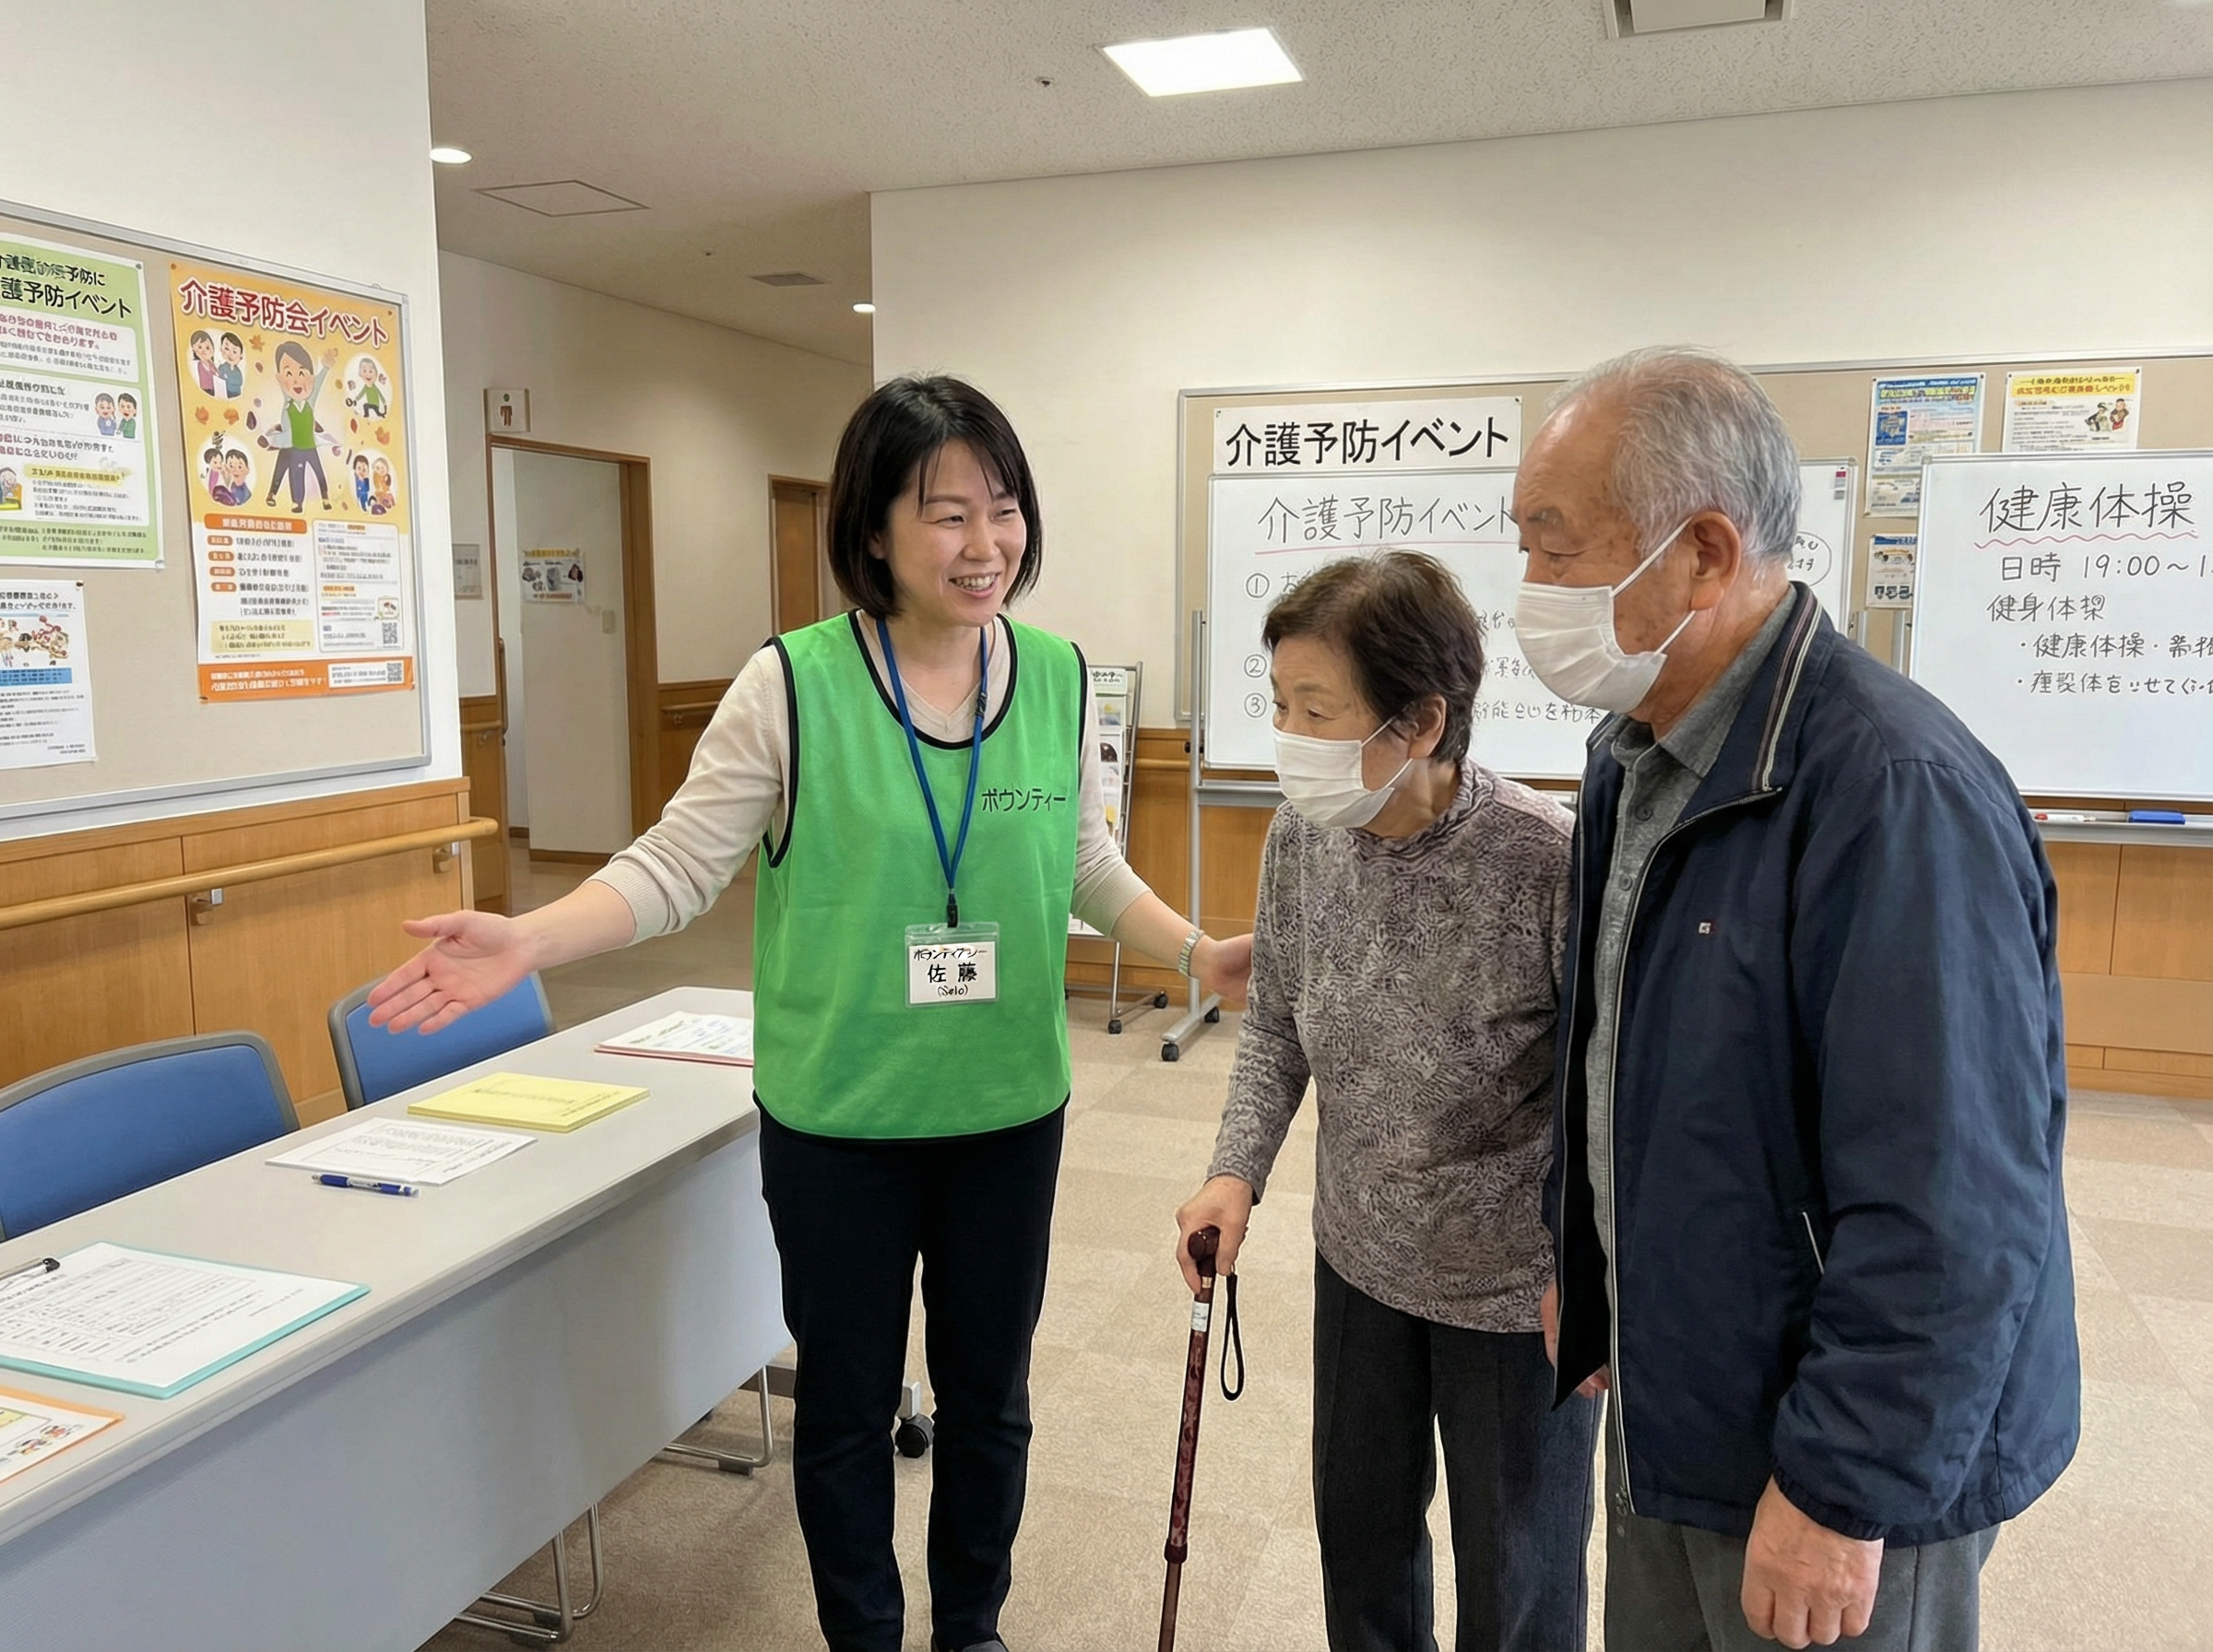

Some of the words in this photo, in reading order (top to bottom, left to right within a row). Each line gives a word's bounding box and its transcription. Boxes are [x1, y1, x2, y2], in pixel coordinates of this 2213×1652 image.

[181, 279, 387, 346] 介護予防会イベント
[1225, 417, 1509, 466] 介護予防イベント
[1258, 494, 1517, 543] 介護予防イベント
[1980, 481, 2195, 533] 健康体操
[2002, 551, 2061, 583] 日時
